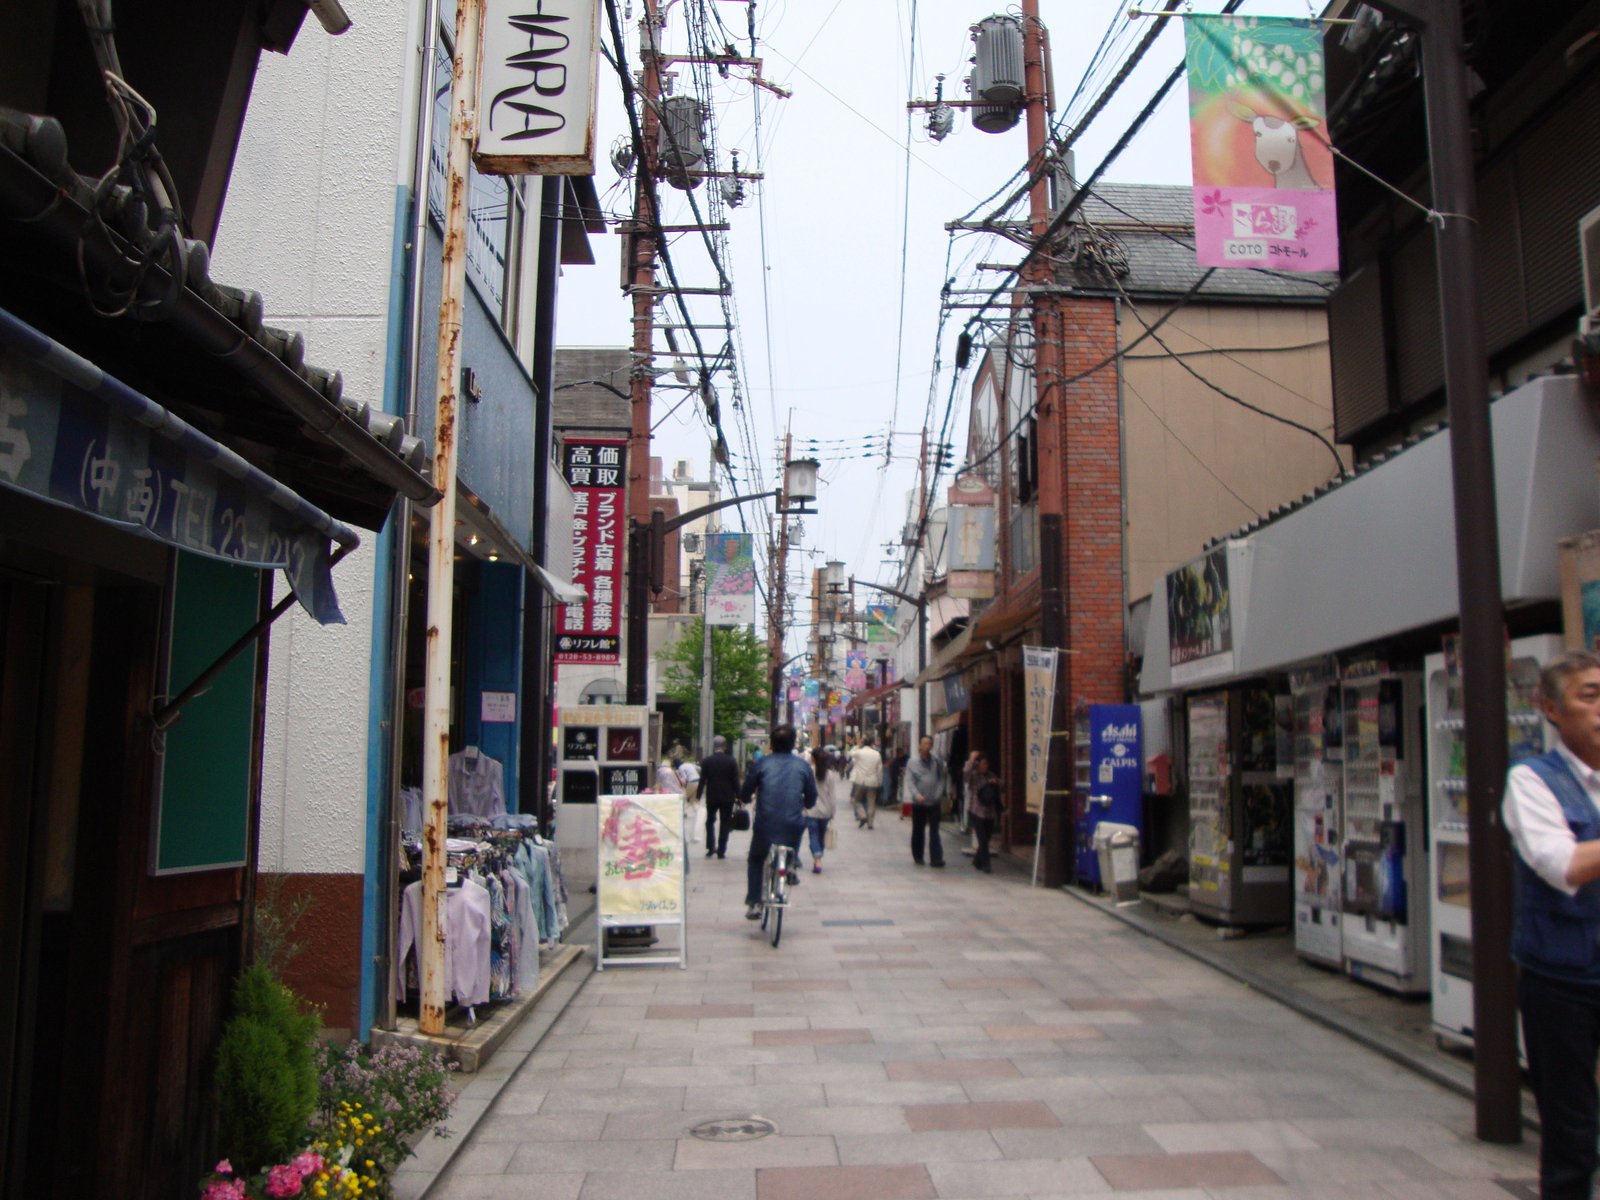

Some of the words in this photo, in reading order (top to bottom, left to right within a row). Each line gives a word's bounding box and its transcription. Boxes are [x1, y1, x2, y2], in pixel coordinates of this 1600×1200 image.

[1269, 245, 1309, 258] コトモール
[571, 446, 620, 465] 高価
[570, 468, 618, 485] 買取
[1102, 722, 1137, 738] Asahi
[1102, 757, 1137, 768] CALPIS
